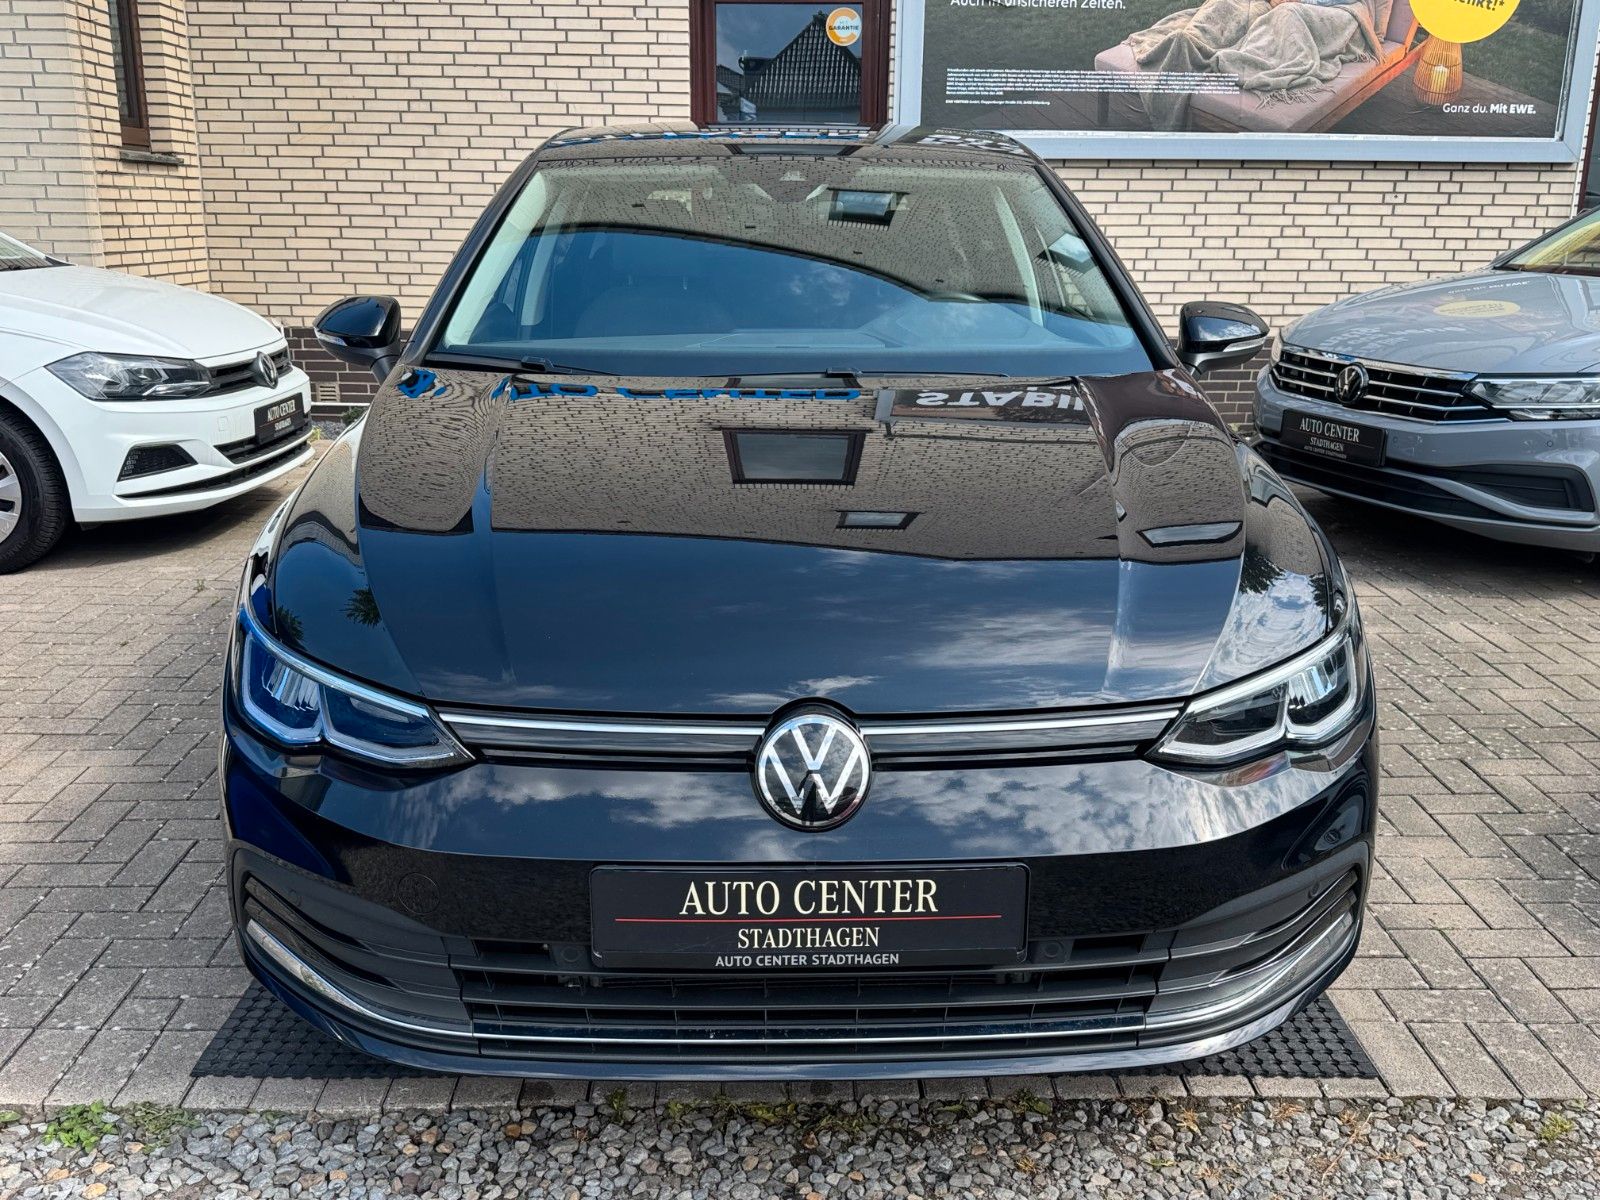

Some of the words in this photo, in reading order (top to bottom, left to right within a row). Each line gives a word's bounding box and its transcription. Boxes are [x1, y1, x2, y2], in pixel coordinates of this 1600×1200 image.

[1442, 103, 1469, 113] Ganz
[1472, 103, 1488, 114] du.
[1490, 103, 1508, 114] Mit
[1509, 105, 1537, 115] EWE.
[1299, 417, 1323, 434] AUTO
[1324, 422, 1360, 442] CENTER
[1310, 436, 1344, 452] STADTHAGEN
[679, 880, 780, 916] AUTO
[793, 879, 938, 915] CENTER
[737, 926, 880, 949] STADTHAGEN
[715, 955, 754, 967] AUTO
[755, 954, 808, 967] CENTER
[811, 952, 900, 966] STADTHAGEN
